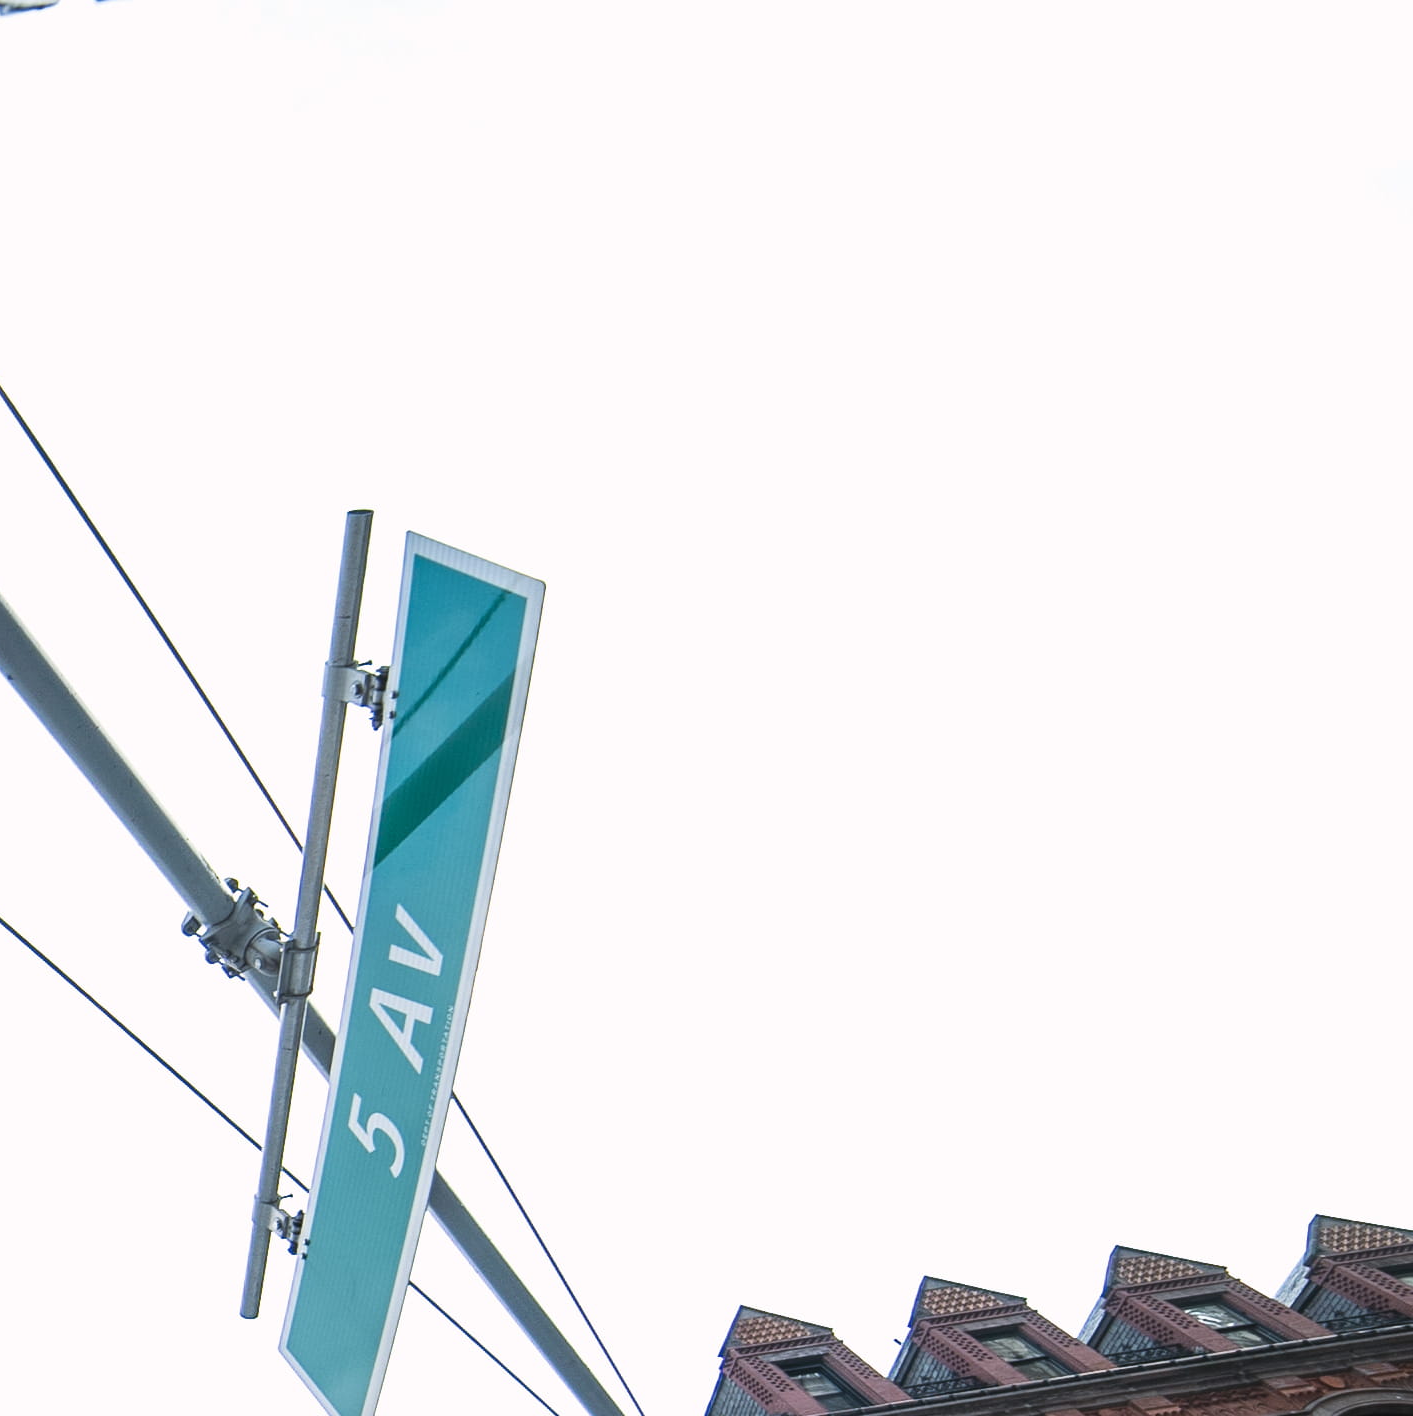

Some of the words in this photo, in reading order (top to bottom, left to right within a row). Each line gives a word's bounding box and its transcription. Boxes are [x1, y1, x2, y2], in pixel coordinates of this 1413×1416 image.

[369, 902, 444, 1075] AV
[429, 1004, 455, 1101] TRANSPORTATION
[348, 1092, 406, 1179] 5
